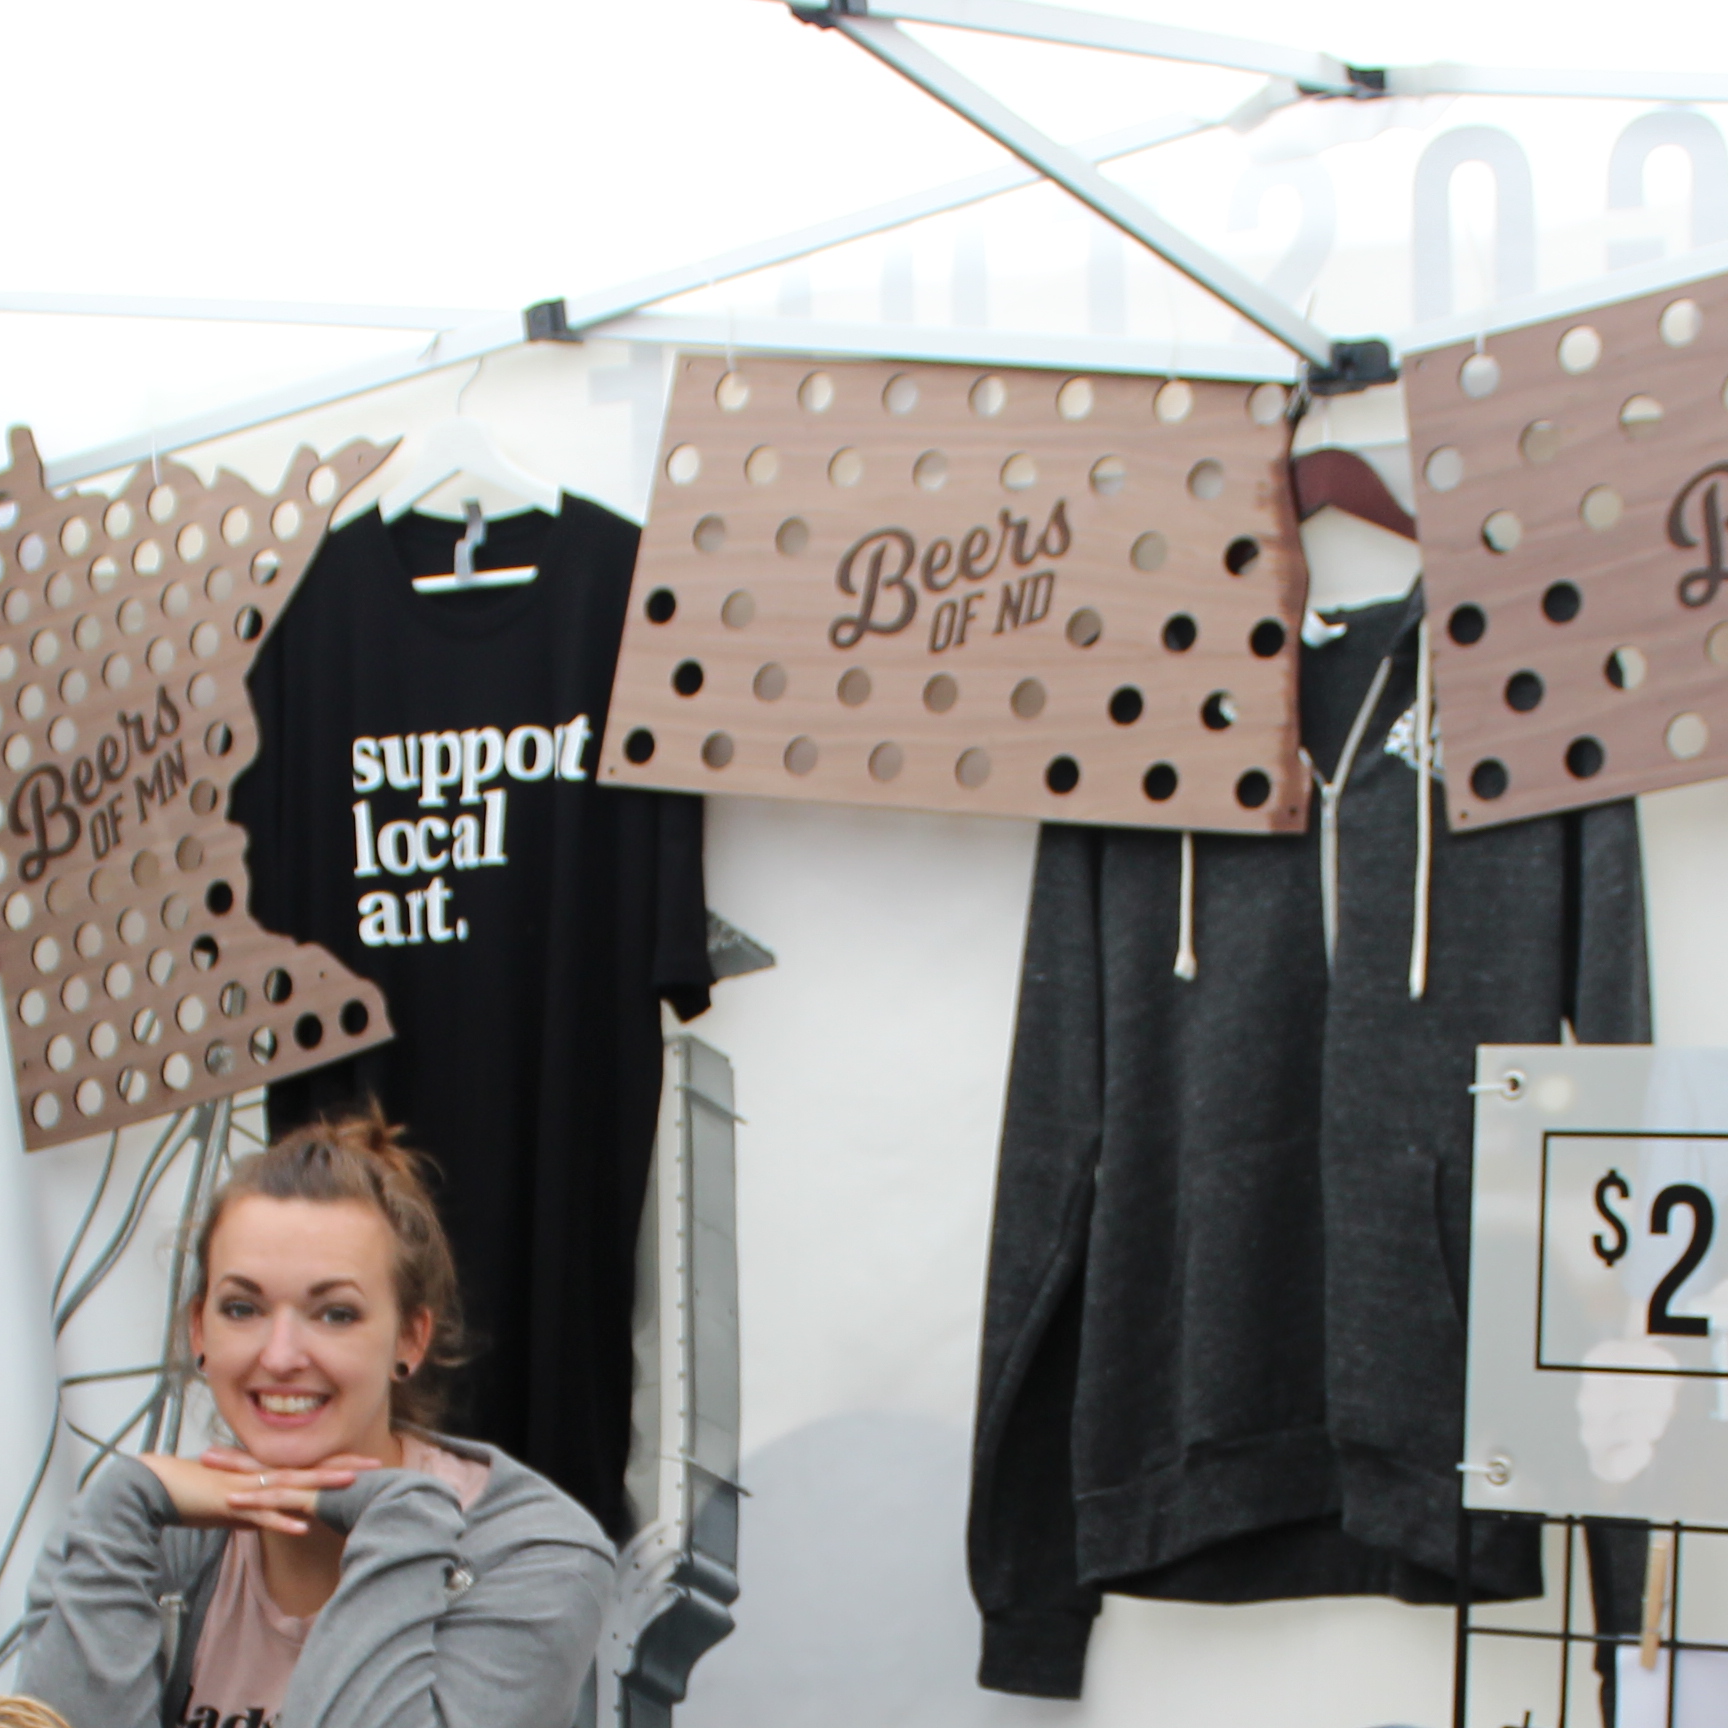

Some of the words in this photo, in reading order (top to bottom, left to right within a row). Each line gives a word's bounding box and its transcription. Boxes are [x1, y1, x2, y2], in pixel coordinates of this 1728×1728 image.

[828, 497, 1074, 651] Beers
[929, 593, 988, 655] OF
[993, 570, 1057, 635] ND
[8, 684, 182, 886] Beers
[87, 812, 129, 862] OF
[137, 743, 190, 823] MN
[353, 714, 591, 806] support
[353, 787, 509, 877] local
[358, 877, 470, 948] art.
